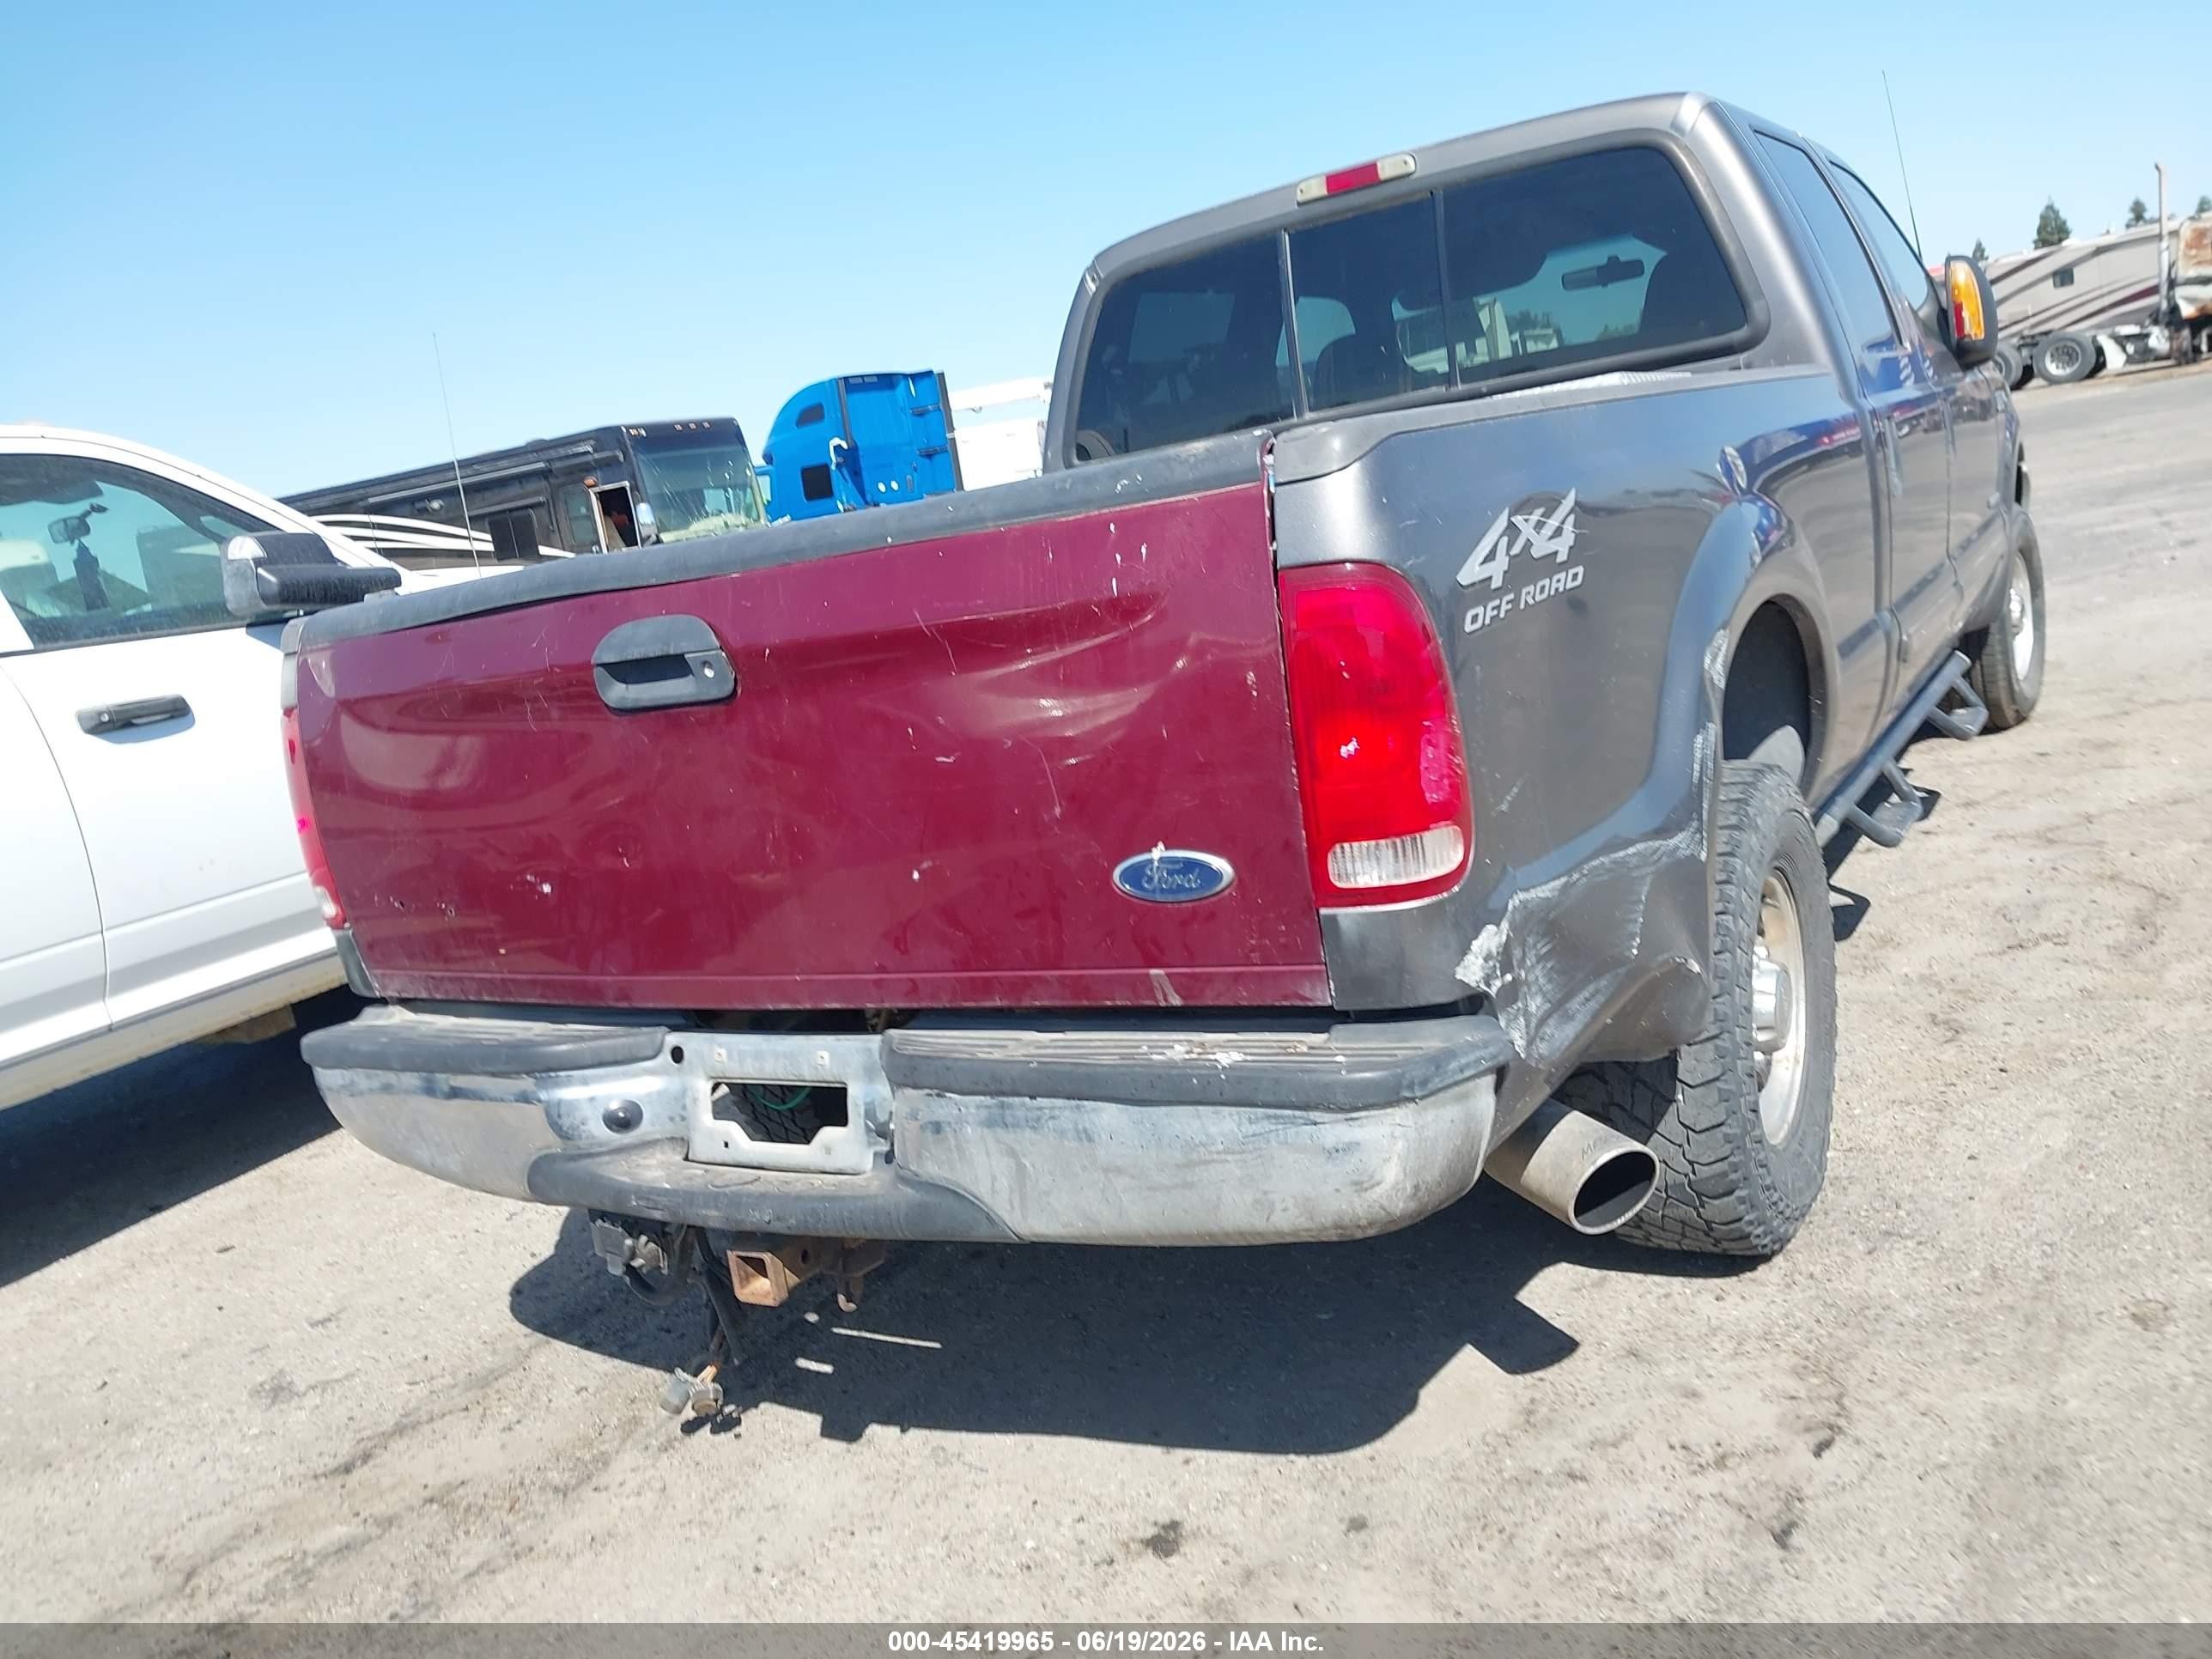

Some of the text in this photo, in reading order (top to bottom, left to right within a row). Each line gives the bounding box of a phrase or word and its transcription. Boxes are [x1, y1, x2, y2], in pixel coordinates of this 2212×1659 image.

[1464, 564, 1584, 634] OFF ROAD
[1141, 860, 1201, 890] Ford
